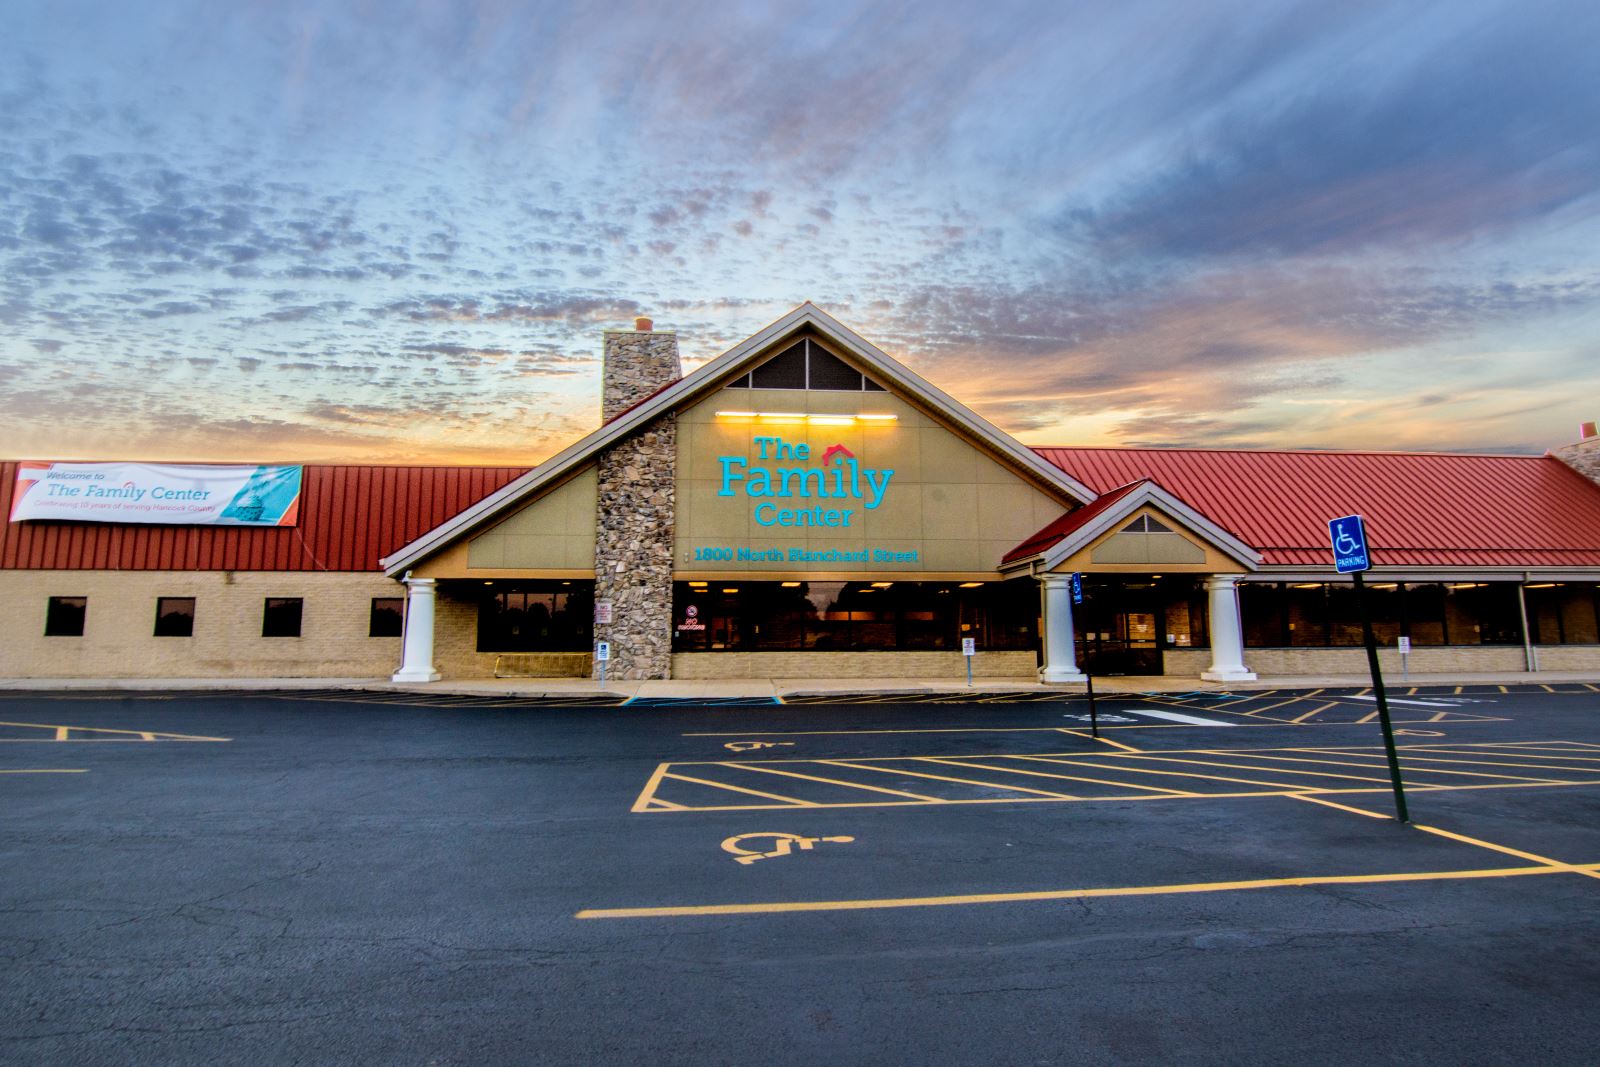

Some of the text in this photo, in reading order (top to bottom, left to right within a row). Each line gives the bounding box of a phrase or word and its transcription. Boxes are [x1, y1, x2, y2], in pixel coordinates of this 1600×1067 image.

[754, 436, 810, 460] The
[47, 471, 105, 480] Welcome to
[717, 456, 895, 509] Family
[48, 483, 211, 501] The Family Center
[90, 503, 112, 511] years
[112, 503, 122, 511] of
[188, 505, 216, 513] County
[754, 502, 854, 528] Center
[694, 547, 918, 563] 1800 North Blanchard Street
[1337, 555, 1365, 567] PARKING
